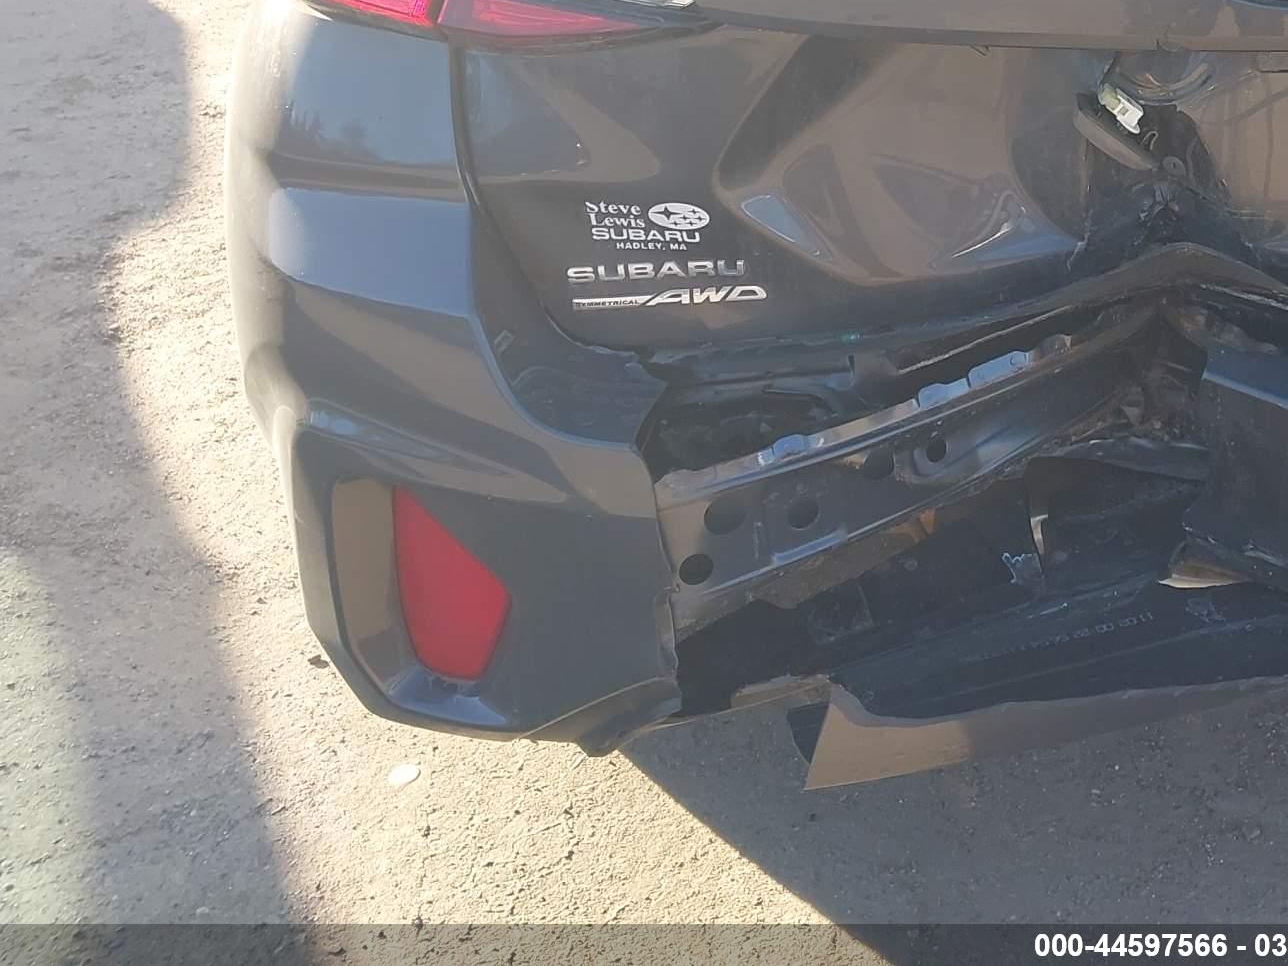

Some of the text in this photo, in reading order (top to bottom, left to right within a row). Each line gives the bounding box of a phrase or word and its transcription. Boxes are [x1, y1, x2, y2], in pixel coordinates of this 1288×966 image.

[585, 200, 641, 215] Steve
[587, 213, 646, 228] Lewis
[591, 227, 701, 243] SUBARU
[616, 242, 688, 251] HADLEY, MA
[567, 259, 745, 283] SUBARU
[644, 285, 768, 307] AWD
